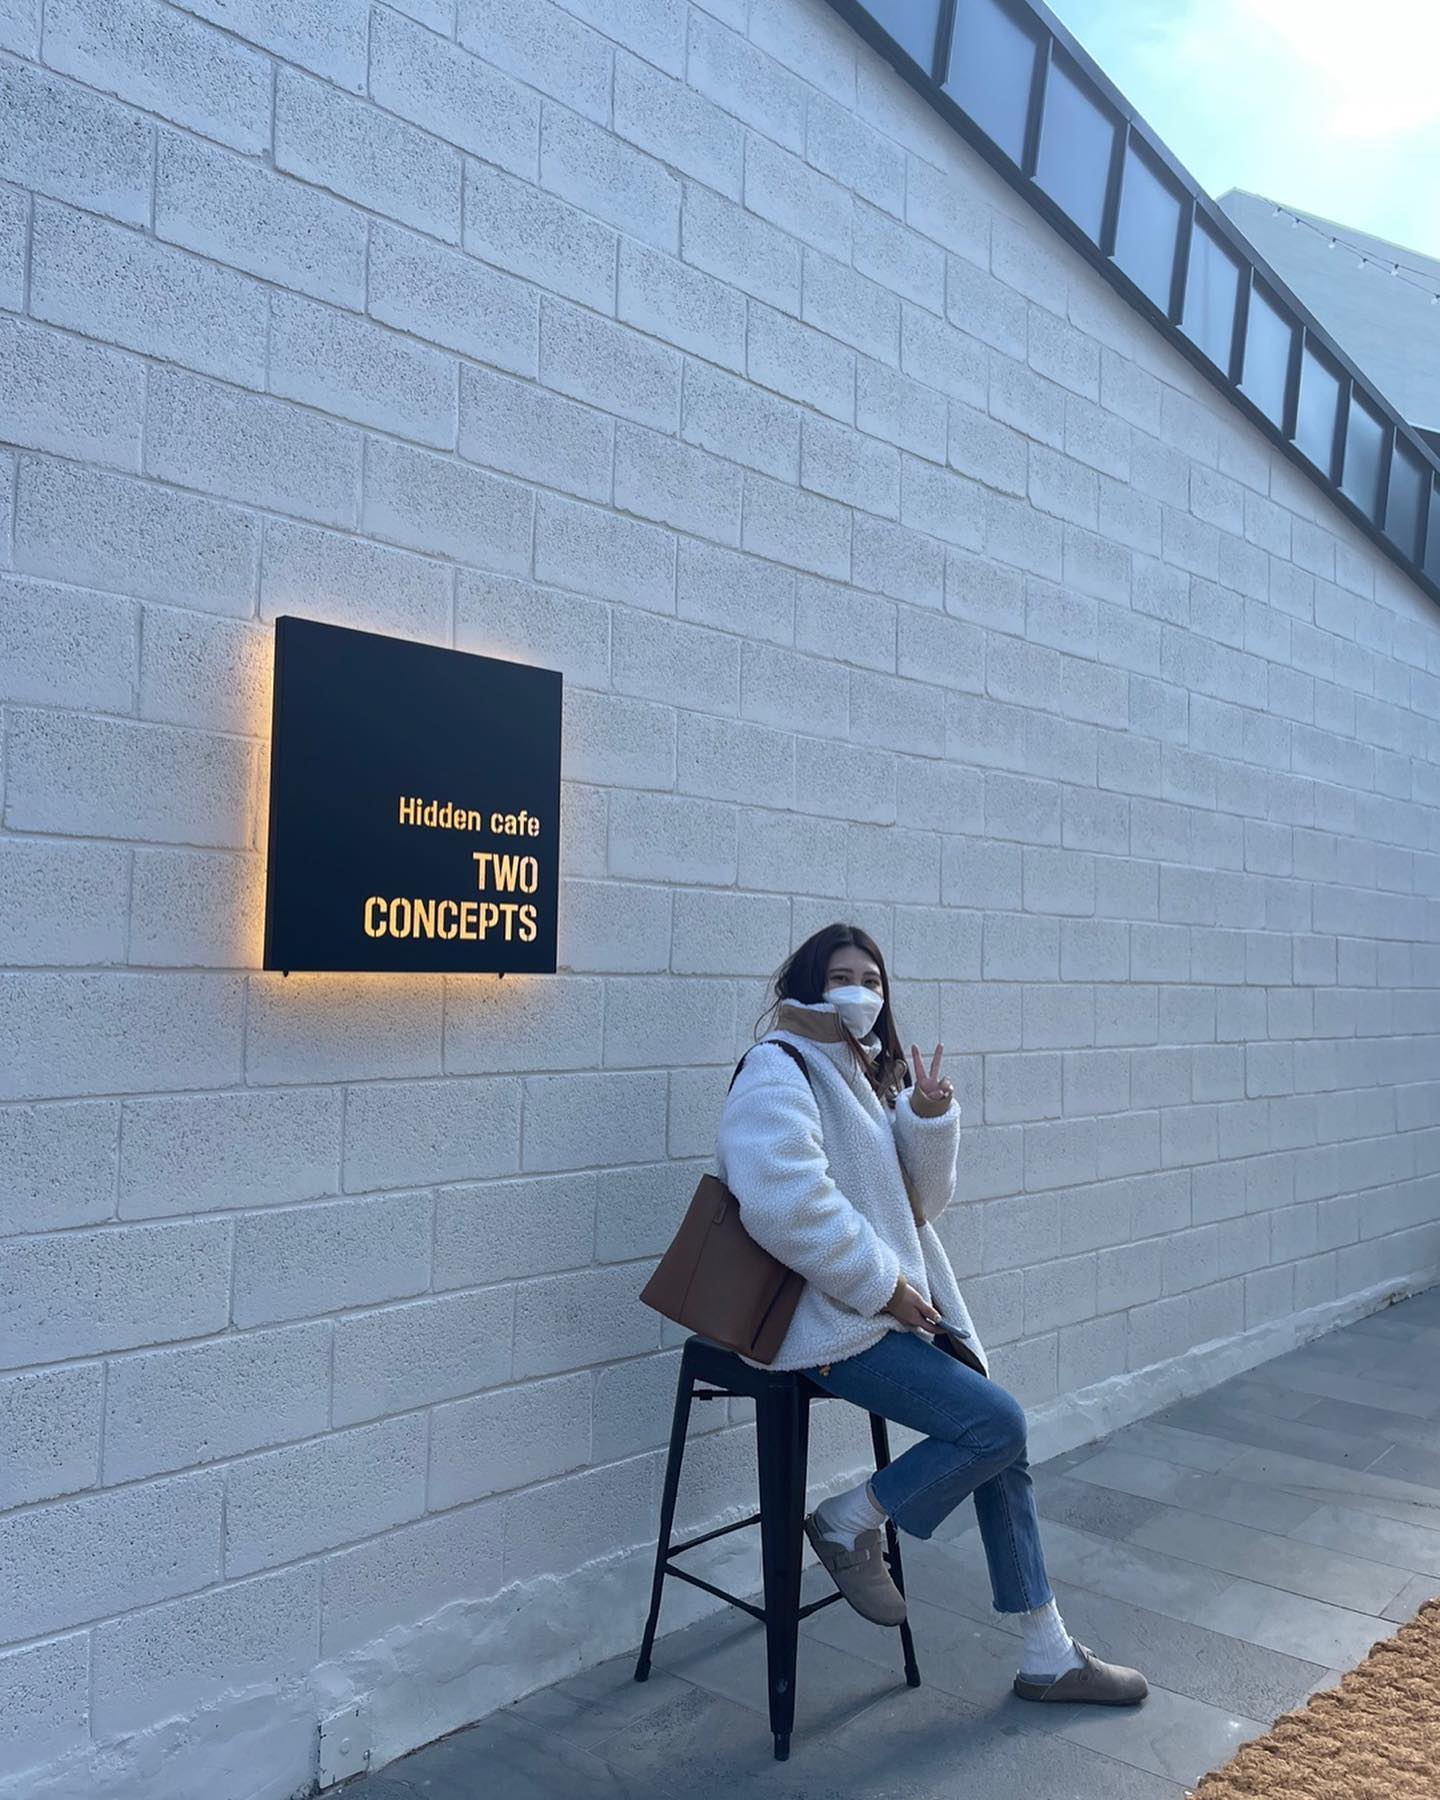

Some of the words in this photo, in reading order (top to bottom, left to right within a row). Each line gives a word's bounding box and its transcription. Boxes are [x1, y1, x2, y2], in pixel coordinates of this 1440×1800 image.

[399, 796, 481, 831] Hidden
[490, 810, 540, 836] cafe
[472, 851, 539, 894] TWO
[364, 896, 537, 942] CONCEPTS
